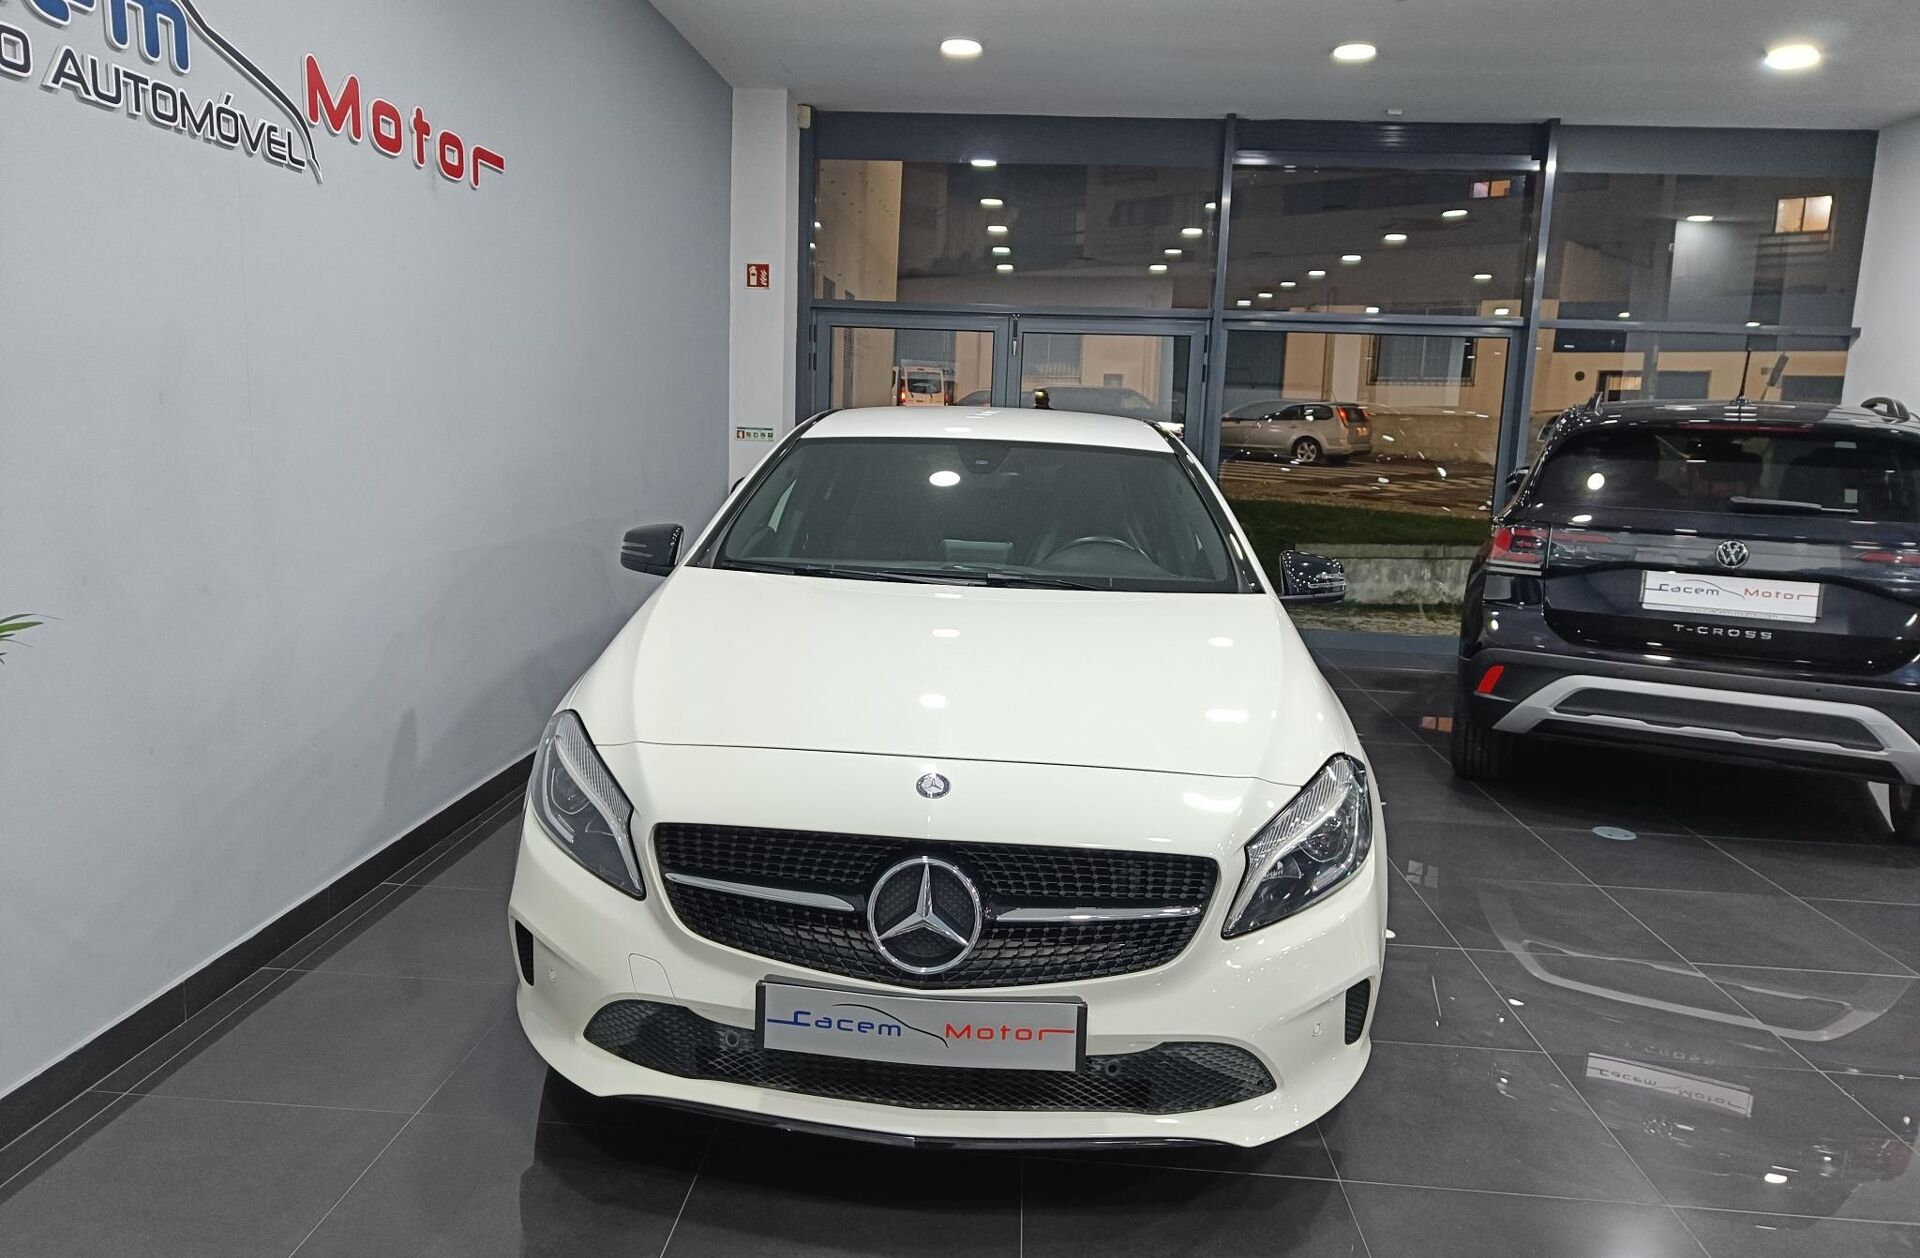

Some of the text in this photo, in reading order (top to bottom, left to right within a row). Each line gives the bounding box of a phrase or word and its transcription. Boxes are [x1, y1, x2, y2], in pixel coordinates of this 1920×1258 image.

[48, 45, 306, 169] AUTOMÓVEL
[302, 53, 505, 188] Motor
[1645, 582, 1820, 601] Cacem Motor
[1673, 623, 1773, 640] T-CROSS
[767, 1010, 1075, 1042] Cacem Motor
